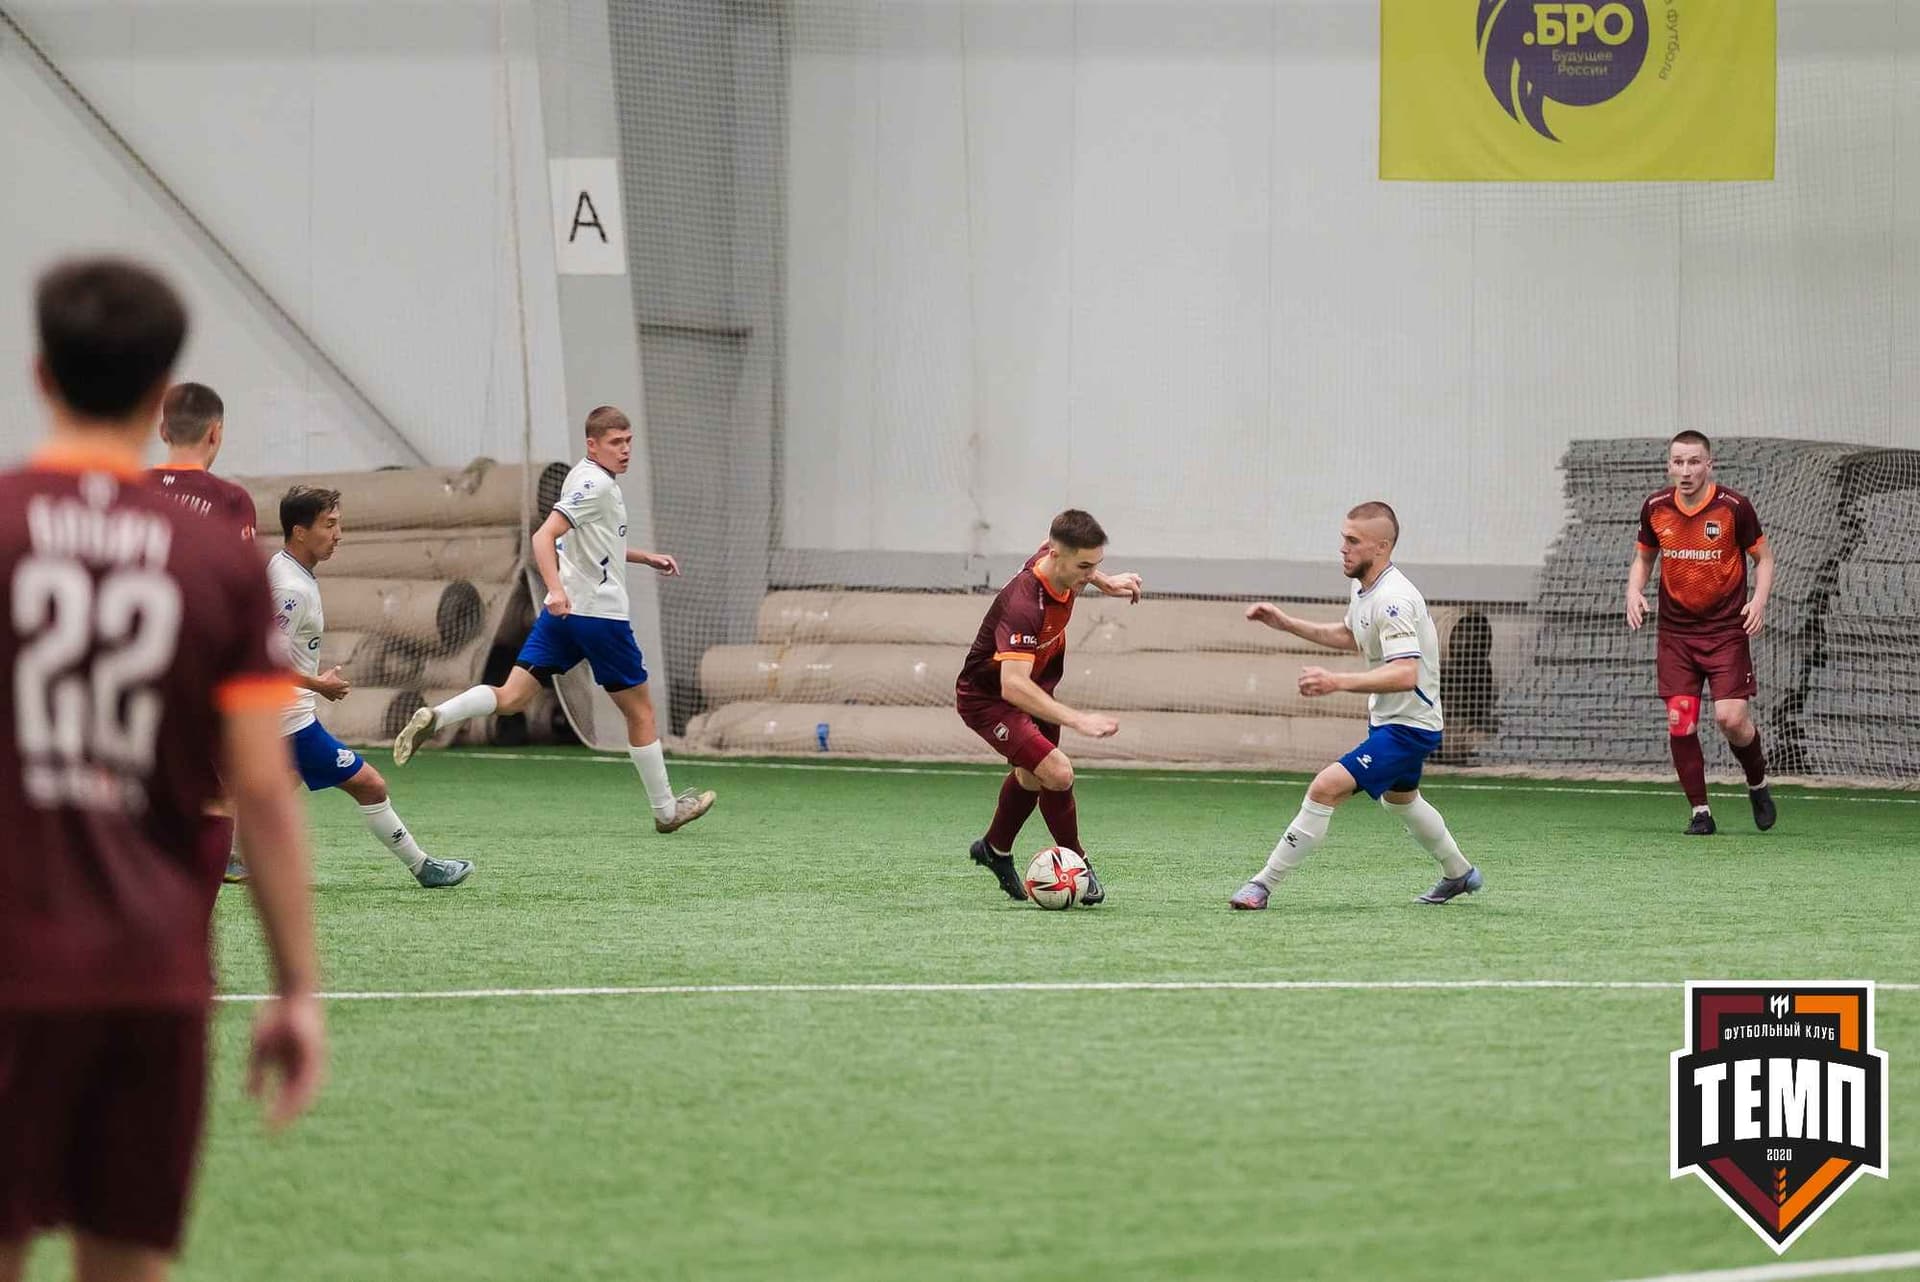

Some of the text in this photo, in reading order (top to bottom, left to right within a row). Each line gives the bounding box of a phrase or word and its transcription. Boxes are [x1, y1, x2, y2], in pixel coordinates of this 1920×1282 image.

[1523, 3, 1633, 45] .БРО
[1552, 49, 1613, 64] Будущее
[1558, 63, 1608, 76] России
[12, 557, 182, 774] 22
